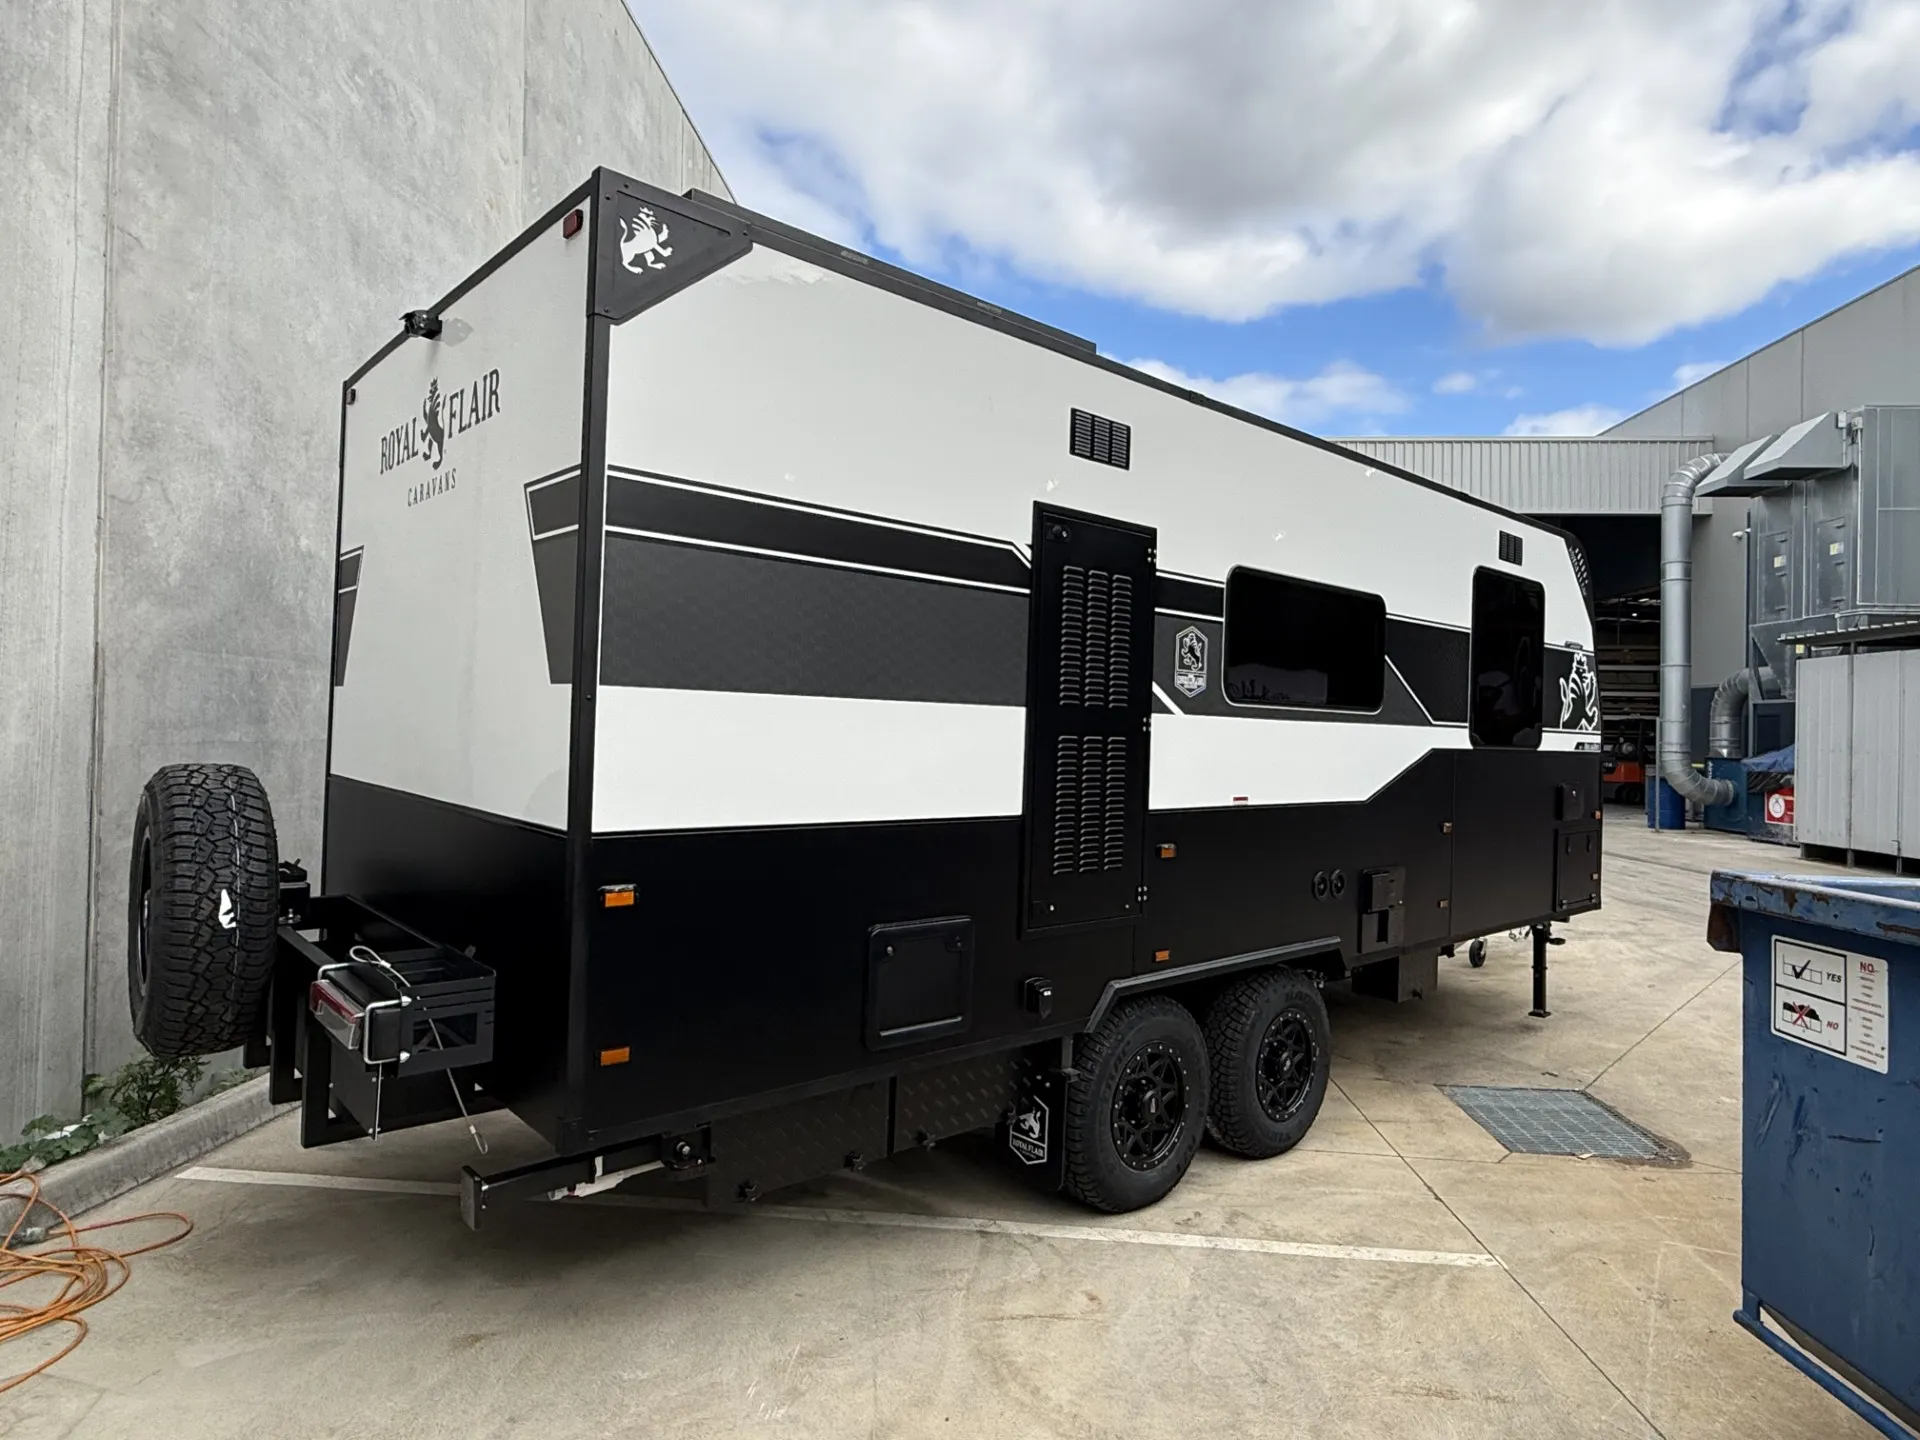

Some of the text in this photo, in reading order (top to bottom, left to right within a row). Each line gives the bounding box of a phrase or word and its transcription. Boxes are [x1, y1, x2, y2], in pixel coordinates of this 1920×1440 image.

[380, 368, 501, 475] ROYAL FLAIR
[407, 468, 457, 507] CARAVANS
[1859, 962, 1874, 973] NO
[1826, 973, 1842, 983] YES
[1826, 1020, 1839, 1030] NO
